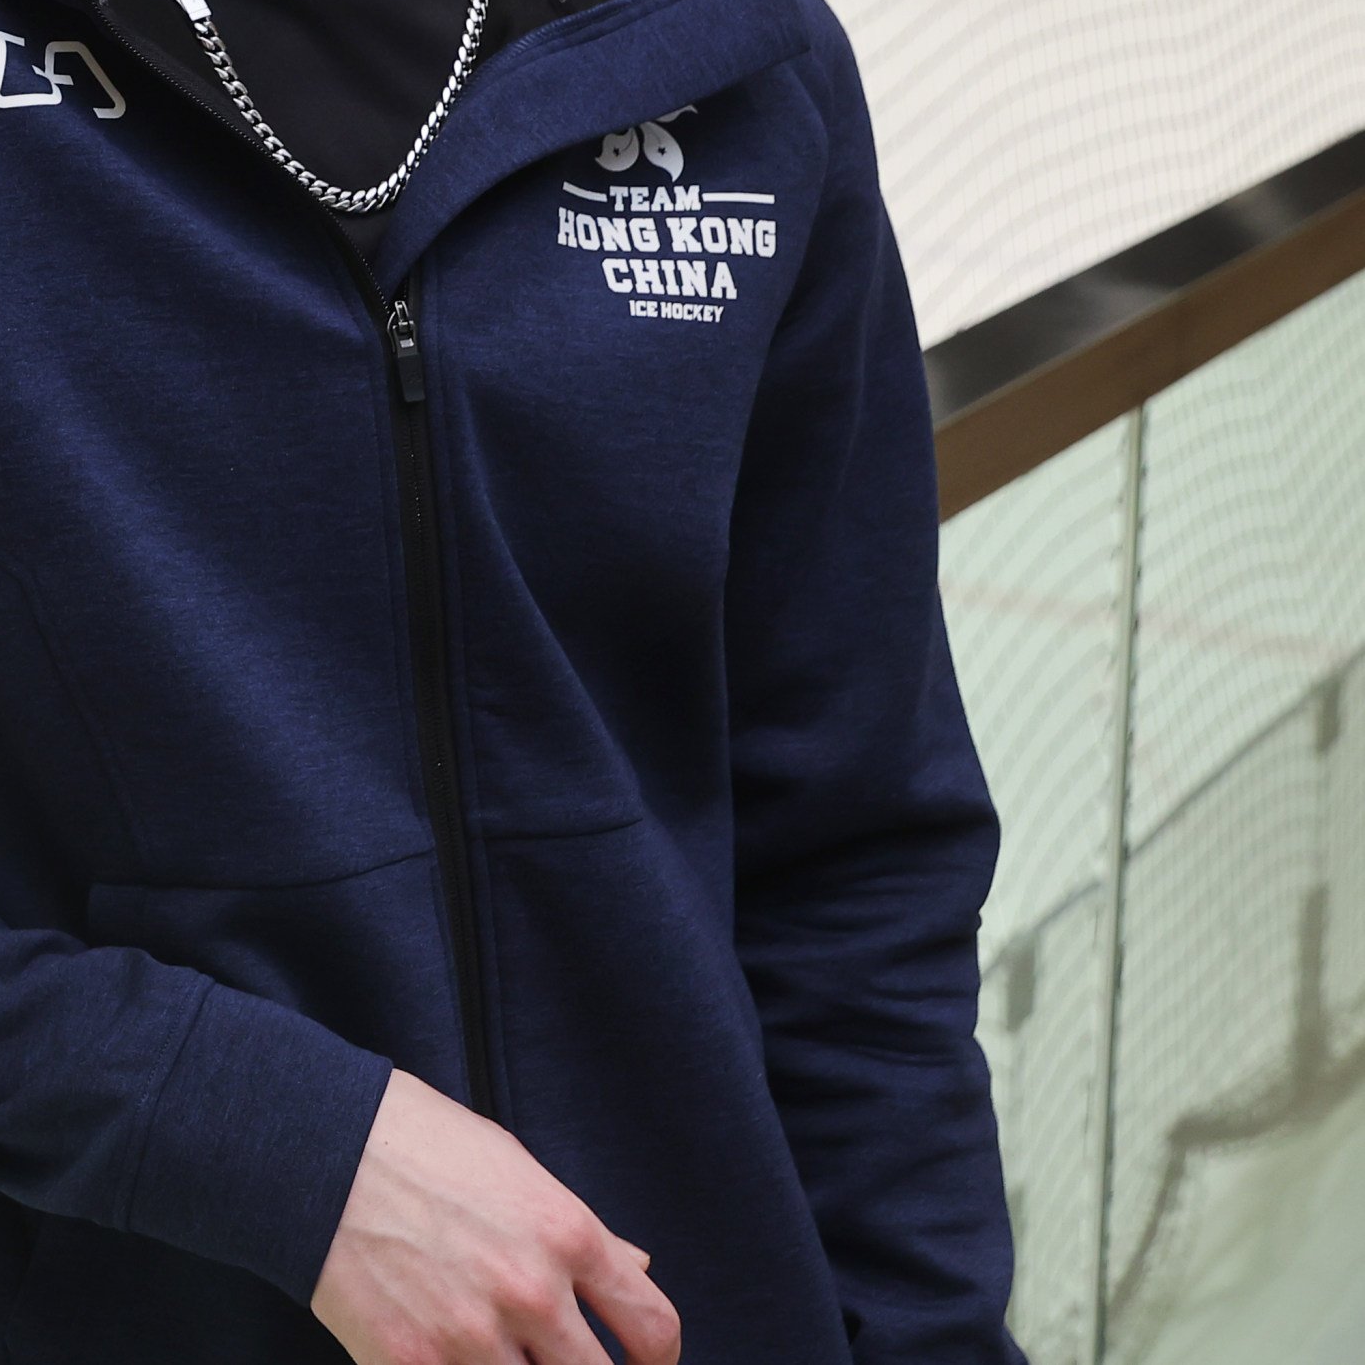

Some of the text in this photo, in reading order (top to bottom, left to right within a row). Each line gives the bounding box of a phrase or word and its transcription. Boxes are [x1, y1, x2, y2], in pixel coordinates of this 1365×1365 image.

[609, 185, 702, 212] TEAM
[557, 207, 776, 258] HONG KONG
[601, 258, 738, 300] CHINA
[629, 300, 724, 323] ICE HOCKEY
